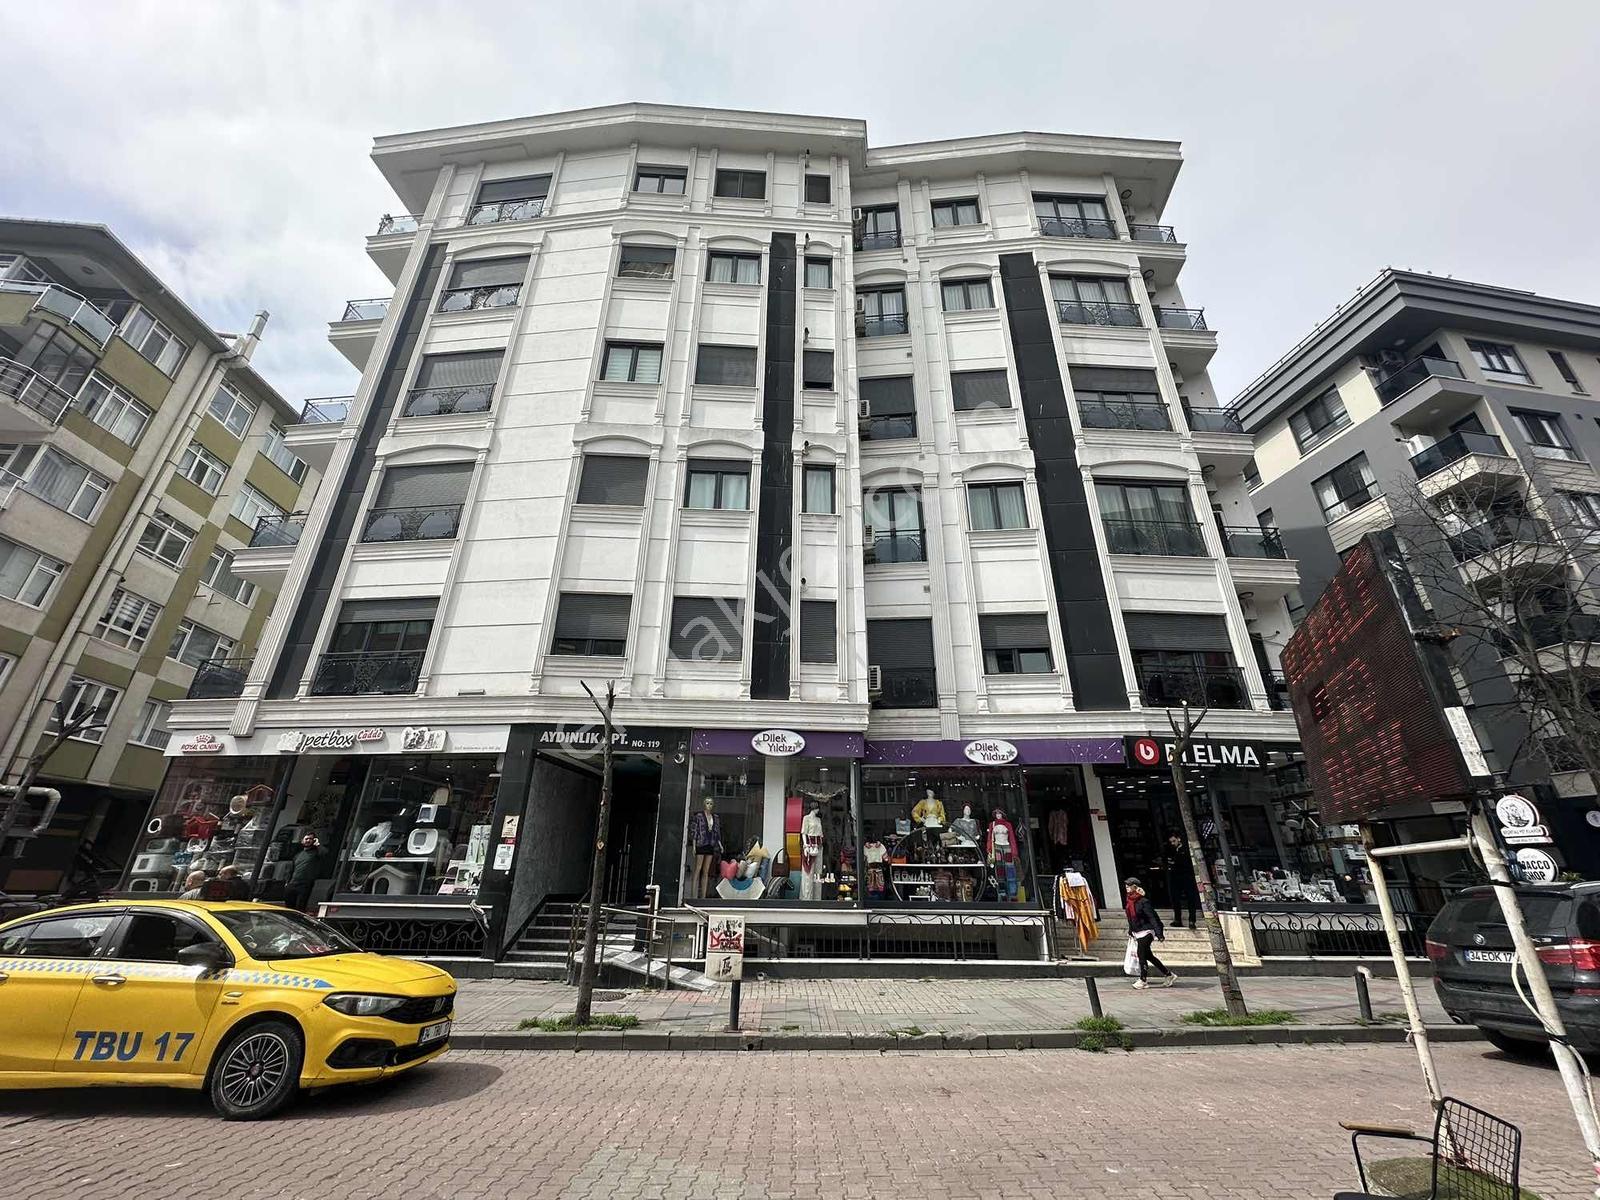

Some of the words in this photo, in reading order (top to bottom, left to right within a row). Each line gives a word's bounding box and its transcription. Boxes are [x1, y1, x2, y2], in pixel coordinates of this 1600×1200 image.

[300, 730, 354, 752] petbox
[357, 728, 383, 740] Cadde
[601, 733, 629, 745] PT.
[632, 740, 646, 748] NO:
[648, 740, 661, 748] 119
[762, 733, 787, 743] Dilek
[199, 742, 219, 750] CANIN
[974, 742, 999, 752] Dilek
[1192, 744, 1260, 765] ELMA
[1470, 950, 1481, 961] 34
[73, 1030, 144, 1061] TBU
[154, 1031, 195, 1062] 17
